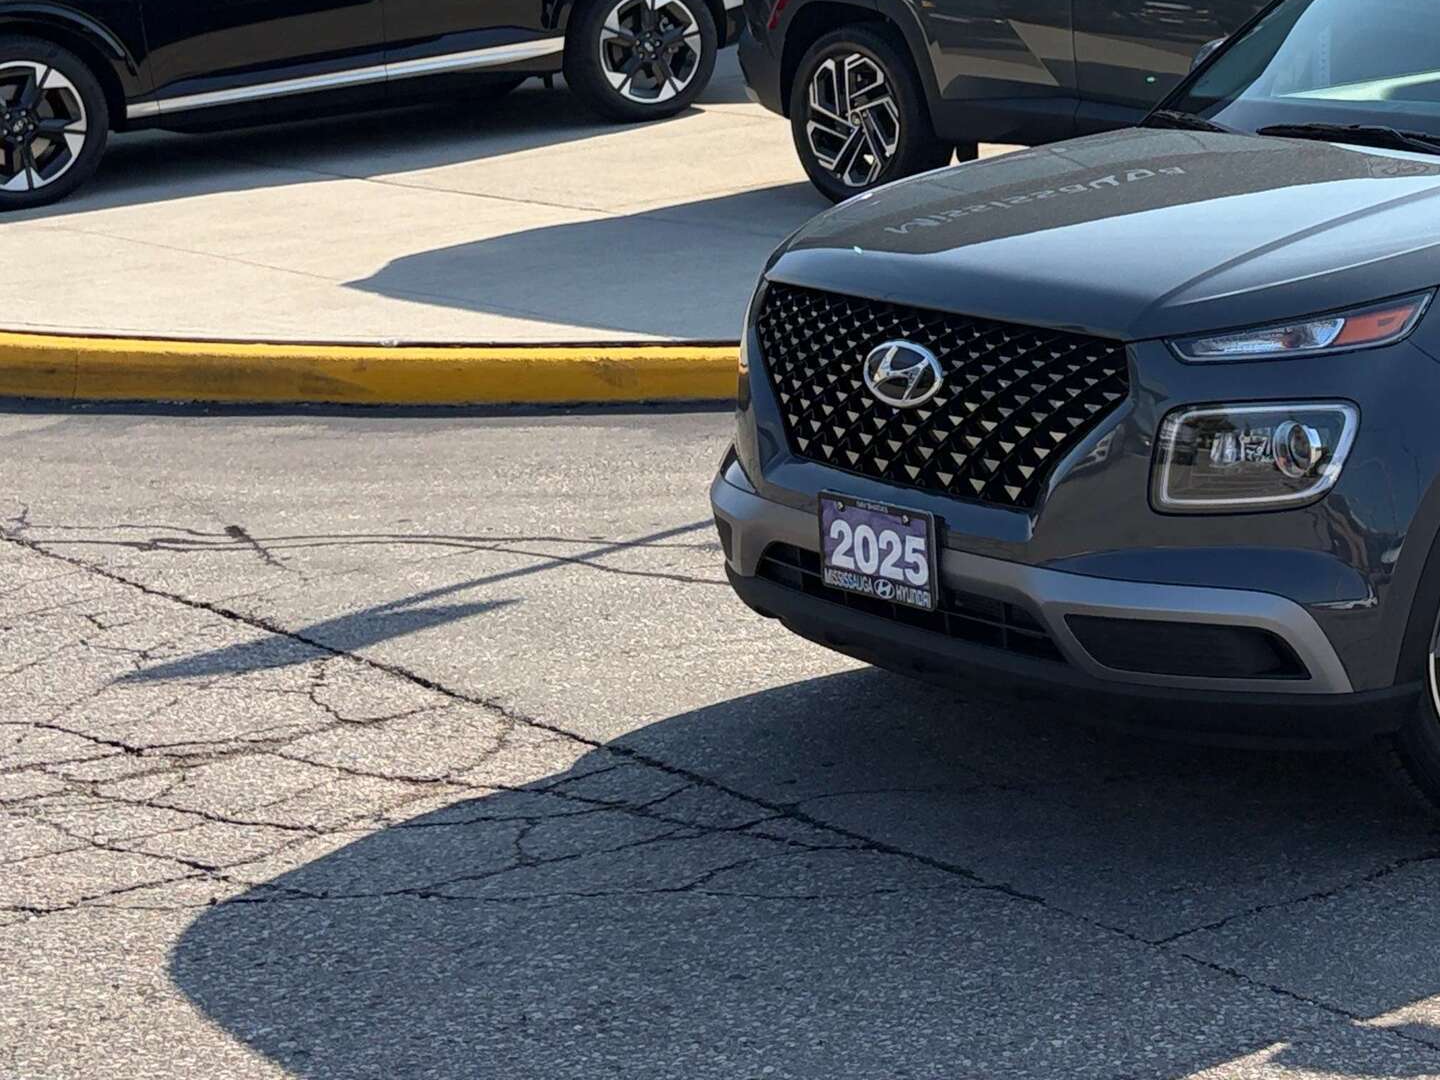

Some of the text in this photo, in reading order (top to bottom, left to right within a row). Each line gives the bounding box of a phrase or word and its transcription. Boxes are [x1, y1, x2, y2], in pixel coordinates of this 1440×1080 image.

[830, 519, 929, 586] 2025
[824, 567, 932, 609] MISSISSAUGA HYUNDAI
